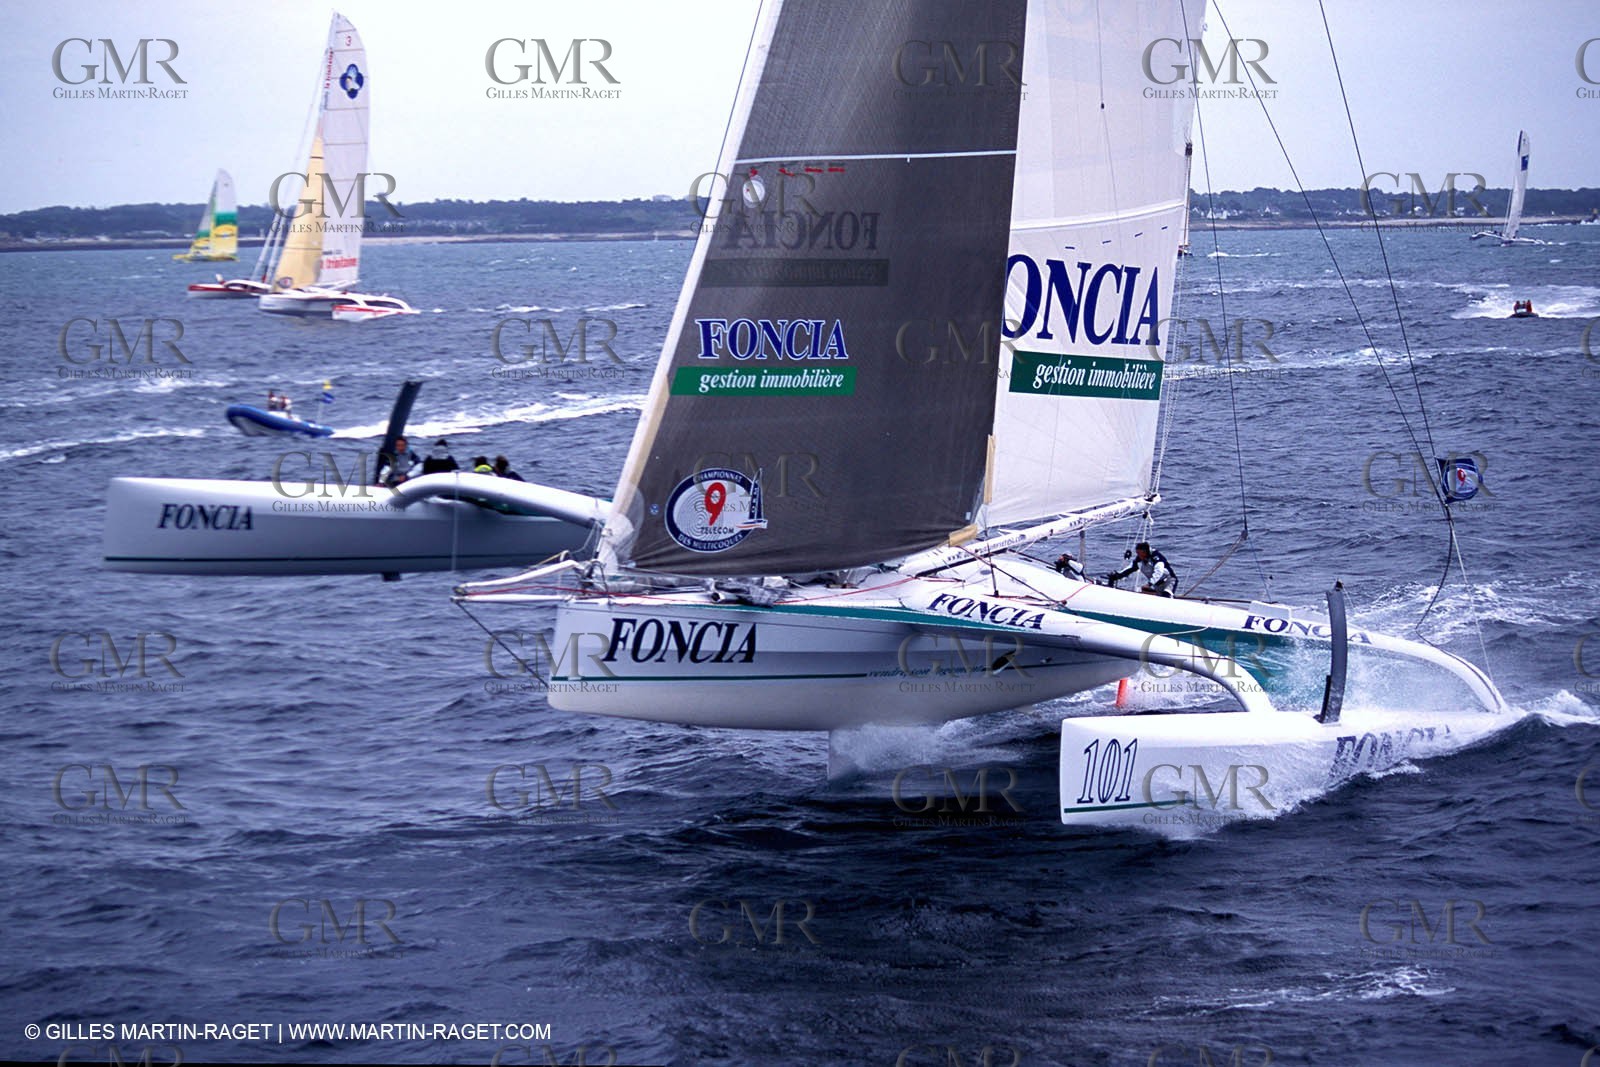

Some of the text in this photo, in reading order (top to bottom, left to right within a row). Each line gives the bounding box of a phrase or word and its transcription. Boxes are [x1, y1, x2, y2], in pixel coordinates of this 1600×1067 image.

[1001, 254, 1160, 345] ONCIA
[695, 318, 849, 360] FONCIA
[698, 368, 844, 393] gestion immobilière
[1032, 360, 1087, 389] gestion
[1087, 361, 1157, 390] immobilière
[157, 503, 254, 531] FONCIA
[704, 482, 726, 526] 9
[926, 593, 1046, 630] FONCIA
[1241, 615, 1373, 645] FONCA
[602, 617, 757, 664] FONCIA
[1077, 737, 1139, 804] 101
